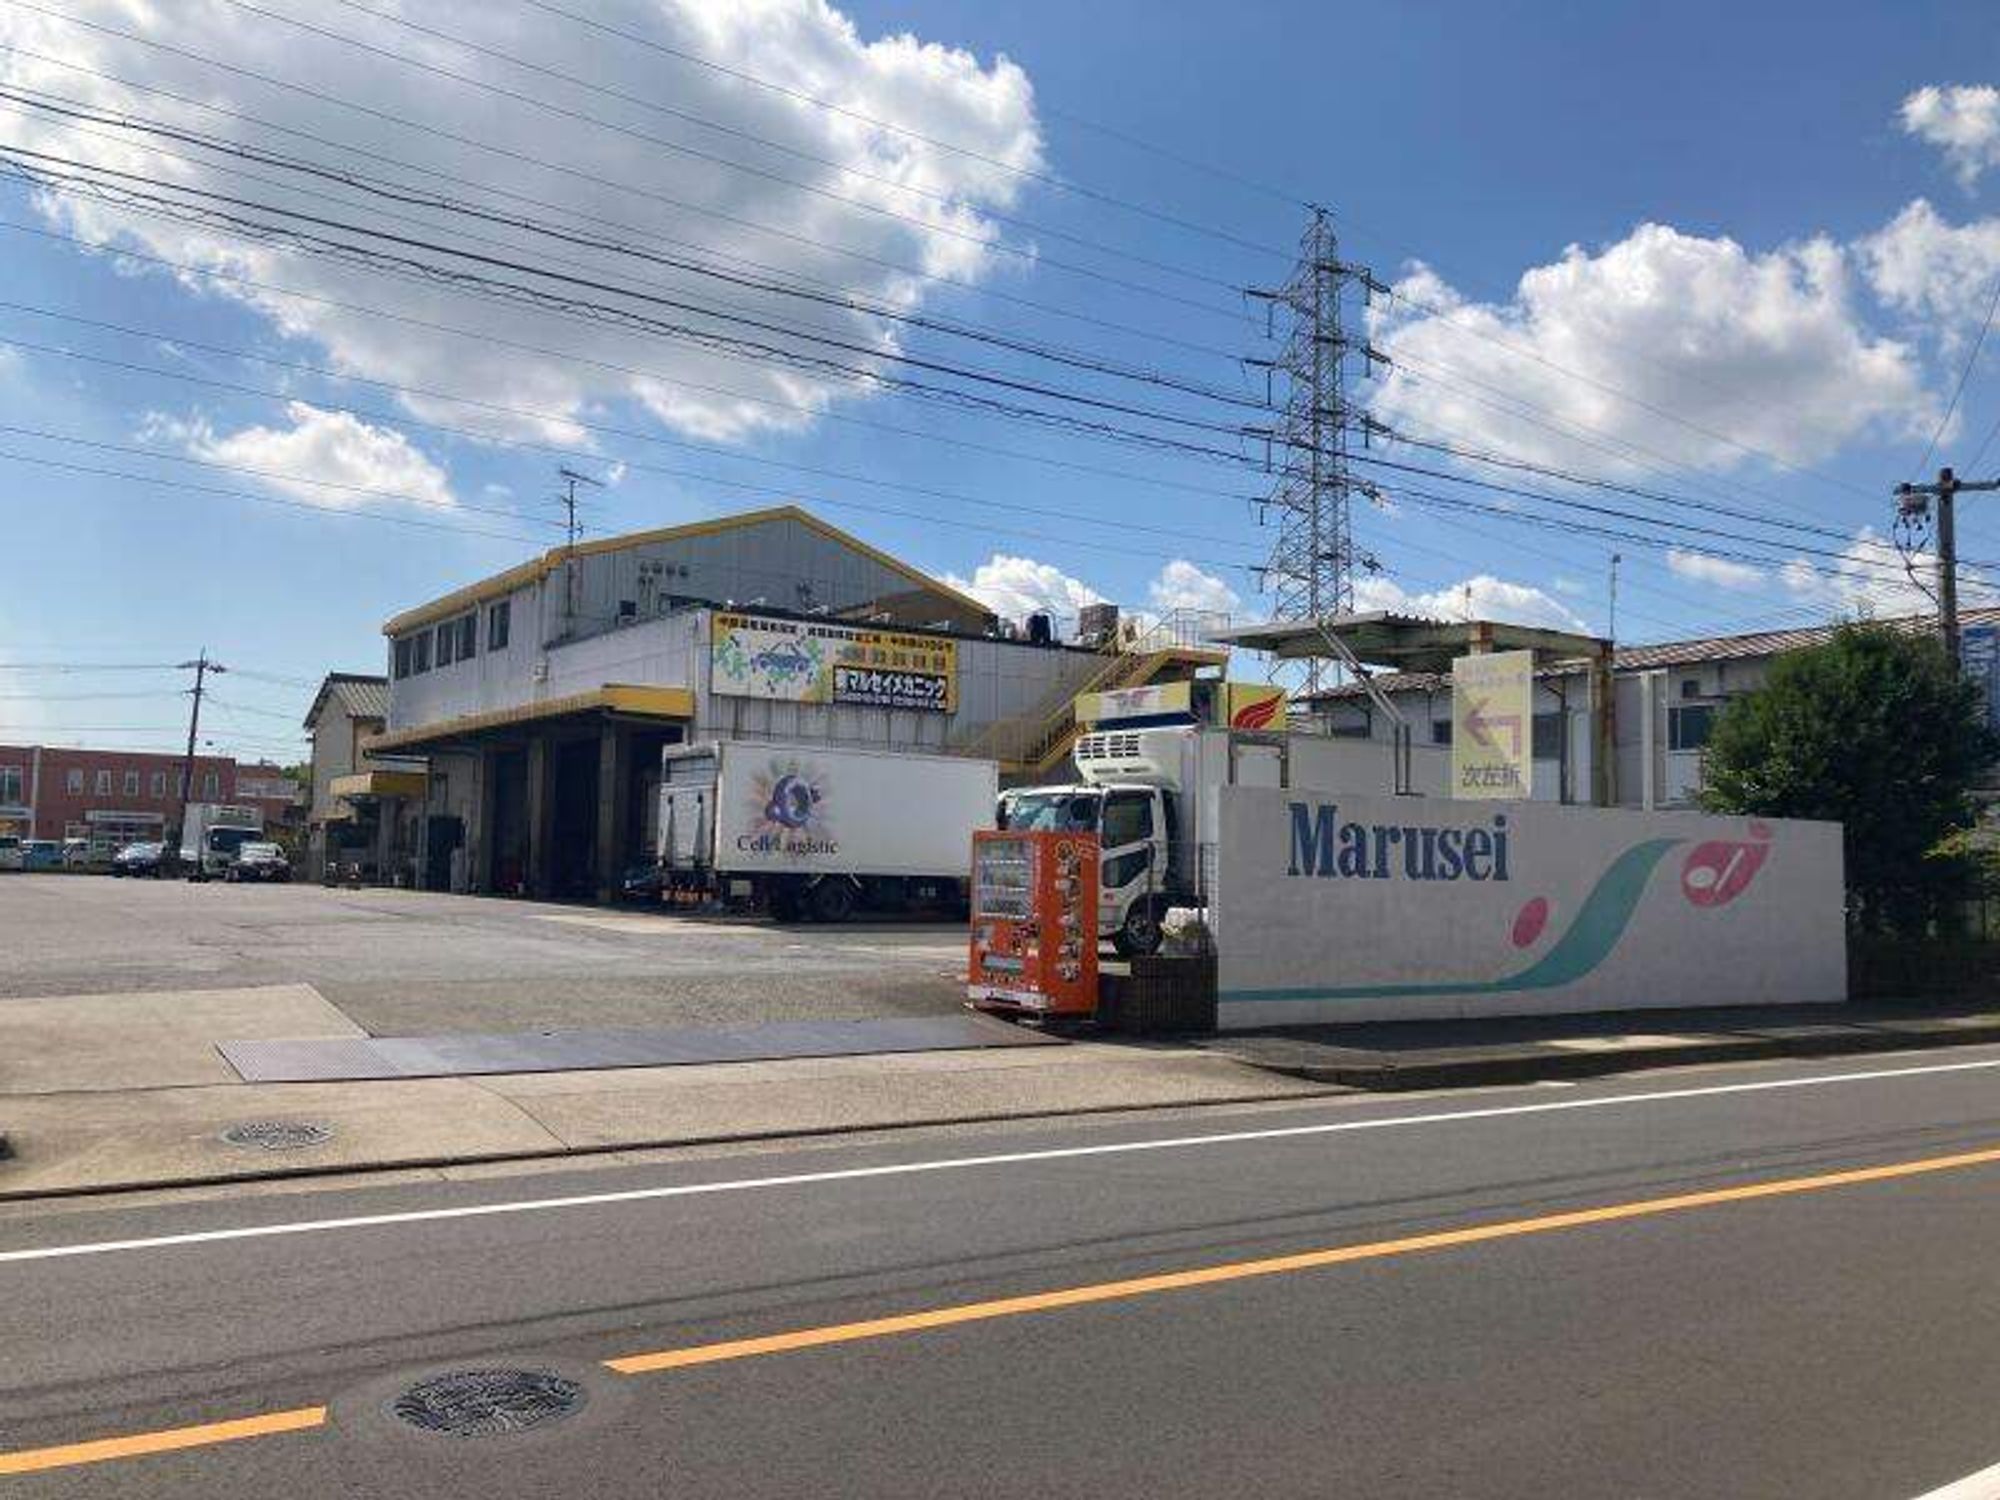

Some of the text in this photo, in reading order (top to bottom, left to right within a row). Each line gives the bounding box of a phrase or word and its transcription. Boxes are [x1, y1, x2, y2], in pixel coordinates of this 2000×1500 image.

[1461, 761, 1520, 788] 次左折
[737, 834, 839, 856] Cell Logistic
[1288, 803, 1508, 881] Marusei
